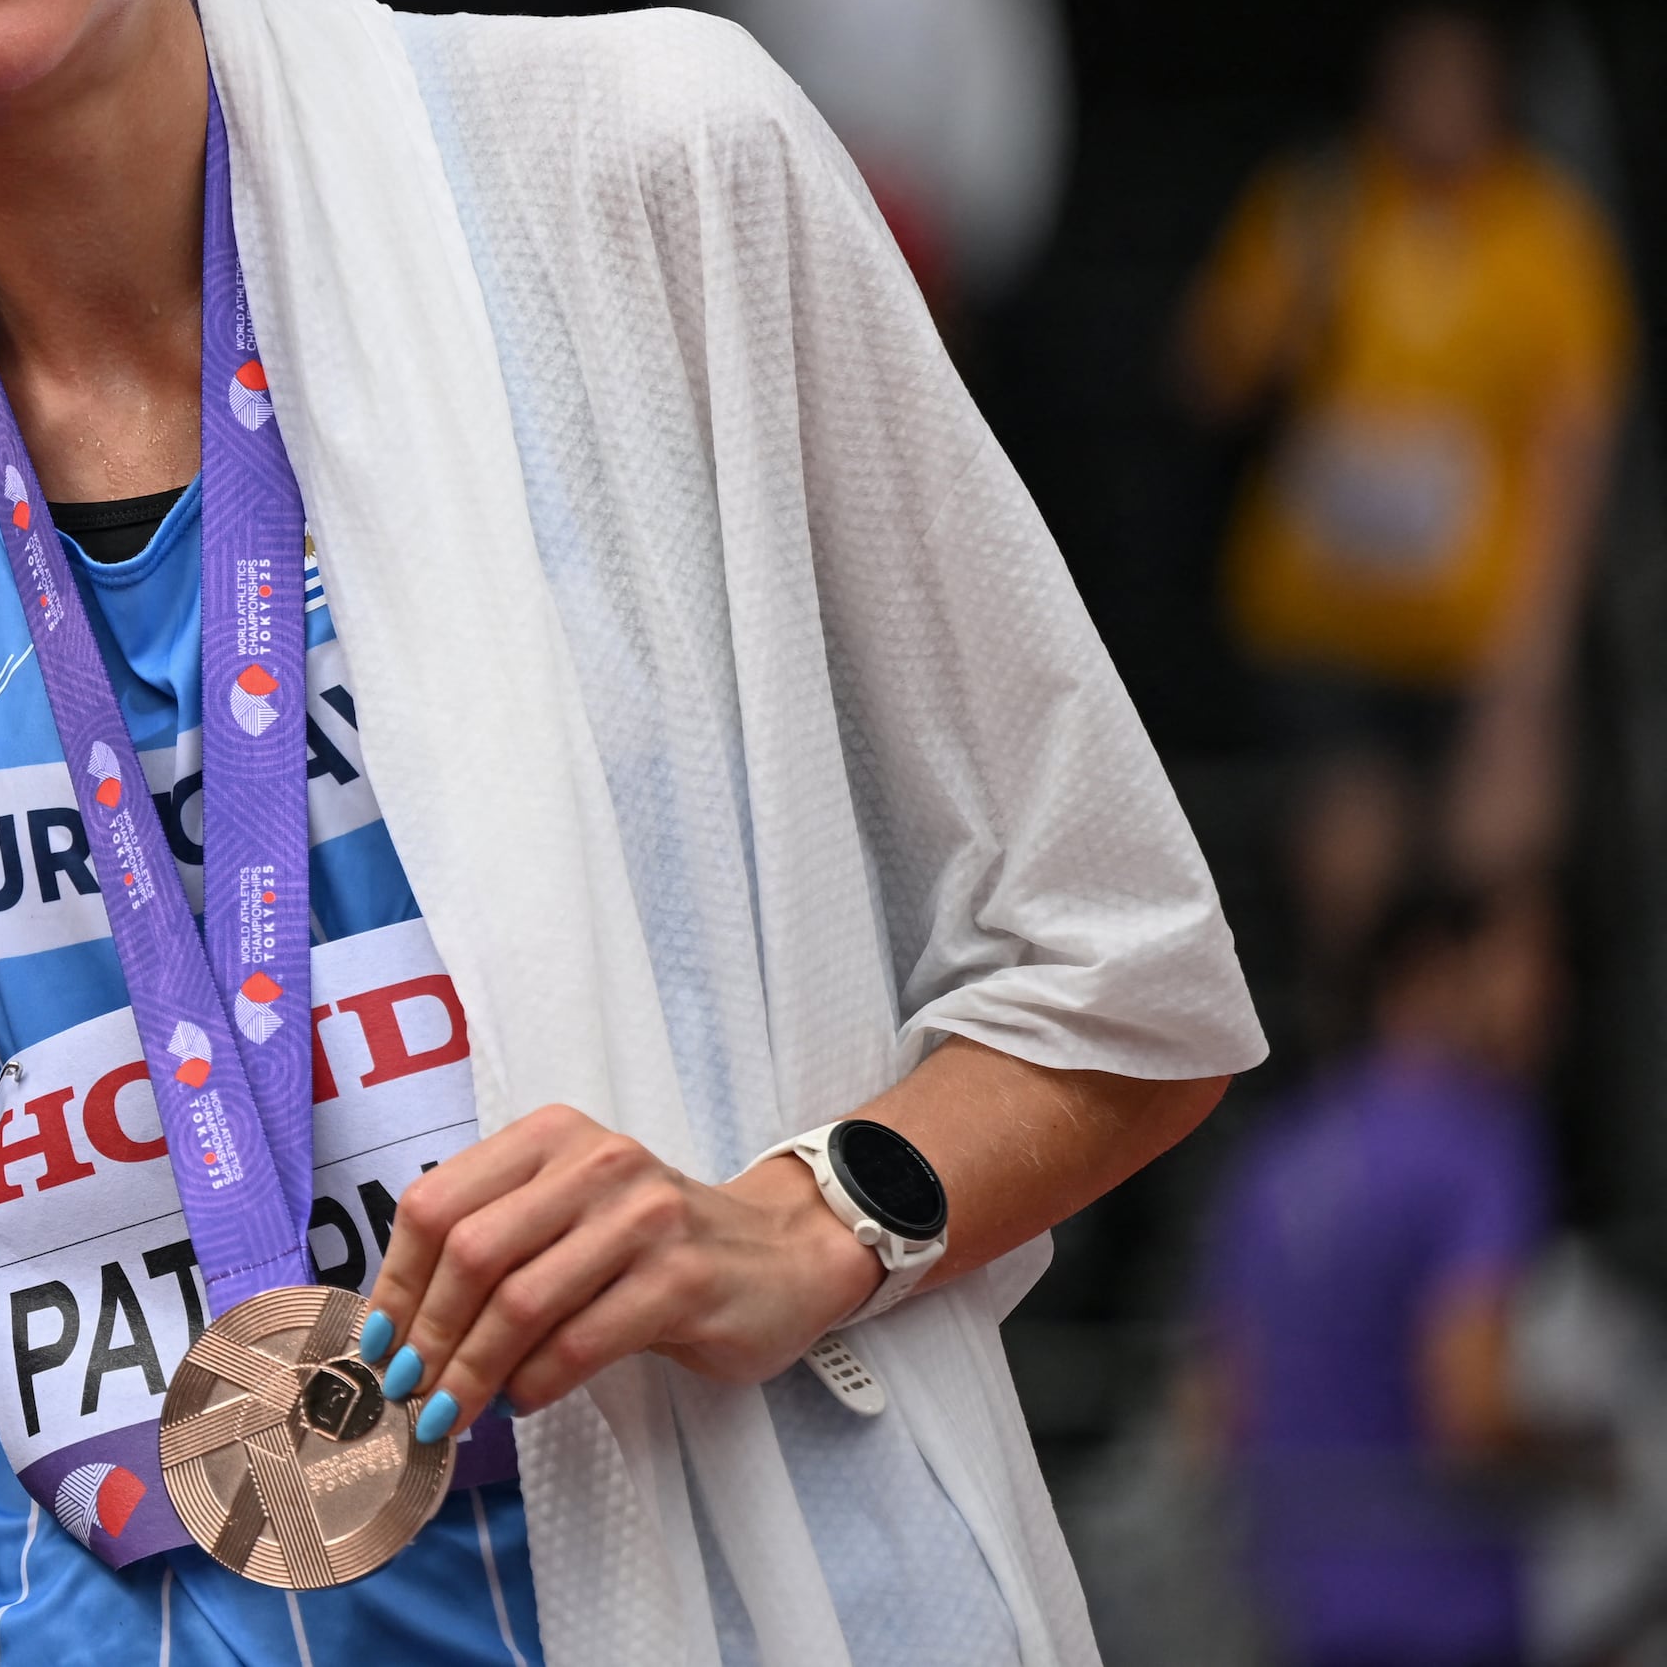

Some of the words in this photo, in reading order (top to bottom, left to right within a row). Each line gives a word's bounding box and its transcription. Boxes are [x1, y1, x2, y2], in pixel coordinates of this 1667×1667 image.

[236, 313, 245, 350] WORLD
[237, 559, 247, 615] ATHLETICS
[259, 559, 271, 580] 25
[248, 559, 258, 656] CHAMPIONSHIPS
[237, 618, 247, 656] WORLD
[116, 814, 147, 904] CHAMPIONSHIPS
[123, 808, 138, 844] WORLD
[134, 846, 155, 898] ATHLETICS
[263, 866, 275, 886] 25
[240, 866, 250, 924] ATHLETICS
[251, 866, 262, 964] CHAMPIONSHIPS
[241, 926, 251, 964] WORLD
[199, 1094, 233, 1185] CHAMPIONSHIPS
[209, 1088, 227, 1126] WORLD
[221, 1128, 243, 1181] ATHLETICS
